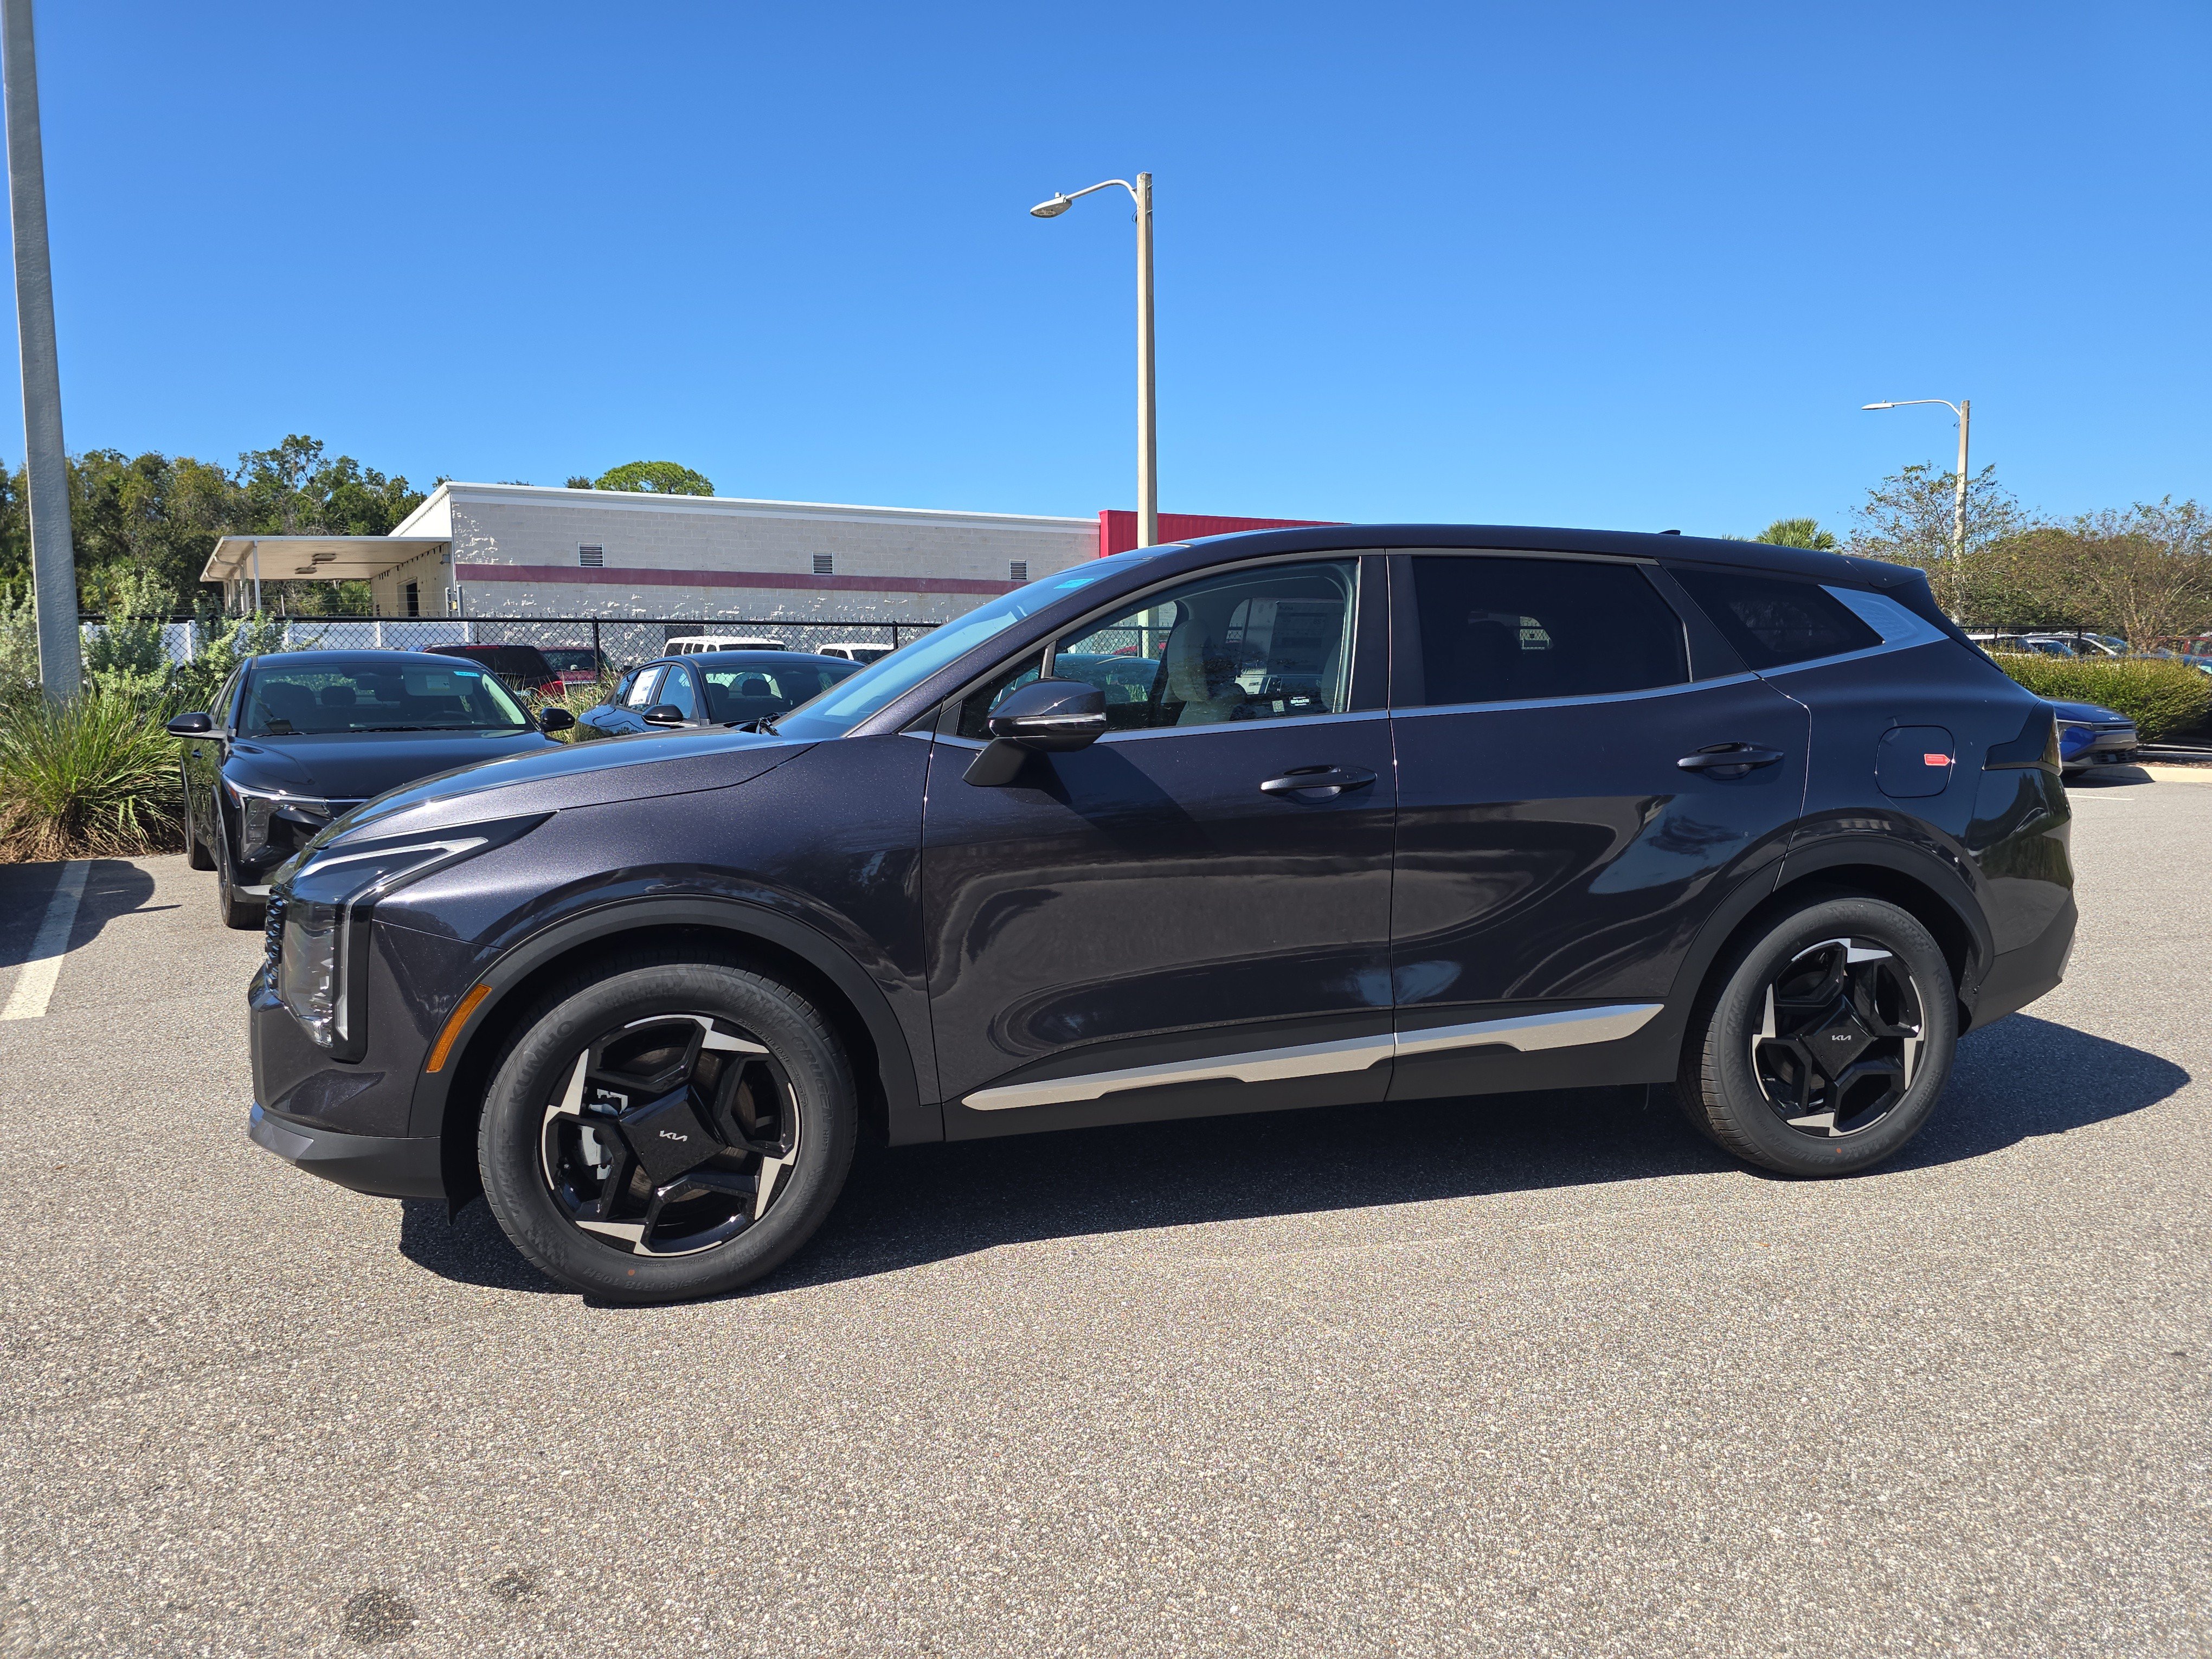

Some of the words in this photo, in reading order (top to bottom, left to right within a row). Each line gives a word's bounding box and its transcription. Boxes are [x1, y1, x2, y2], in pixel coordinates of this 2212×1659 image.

[1932, 968, 1953, 1041] KUMHO
[508, 1020, 575, 1104] KUMHO
[791, 1036, 834, 1126] CRUGEN
[659, 1129, 688, 1142] KIA
[623, 1279, 655, 1291] R18
